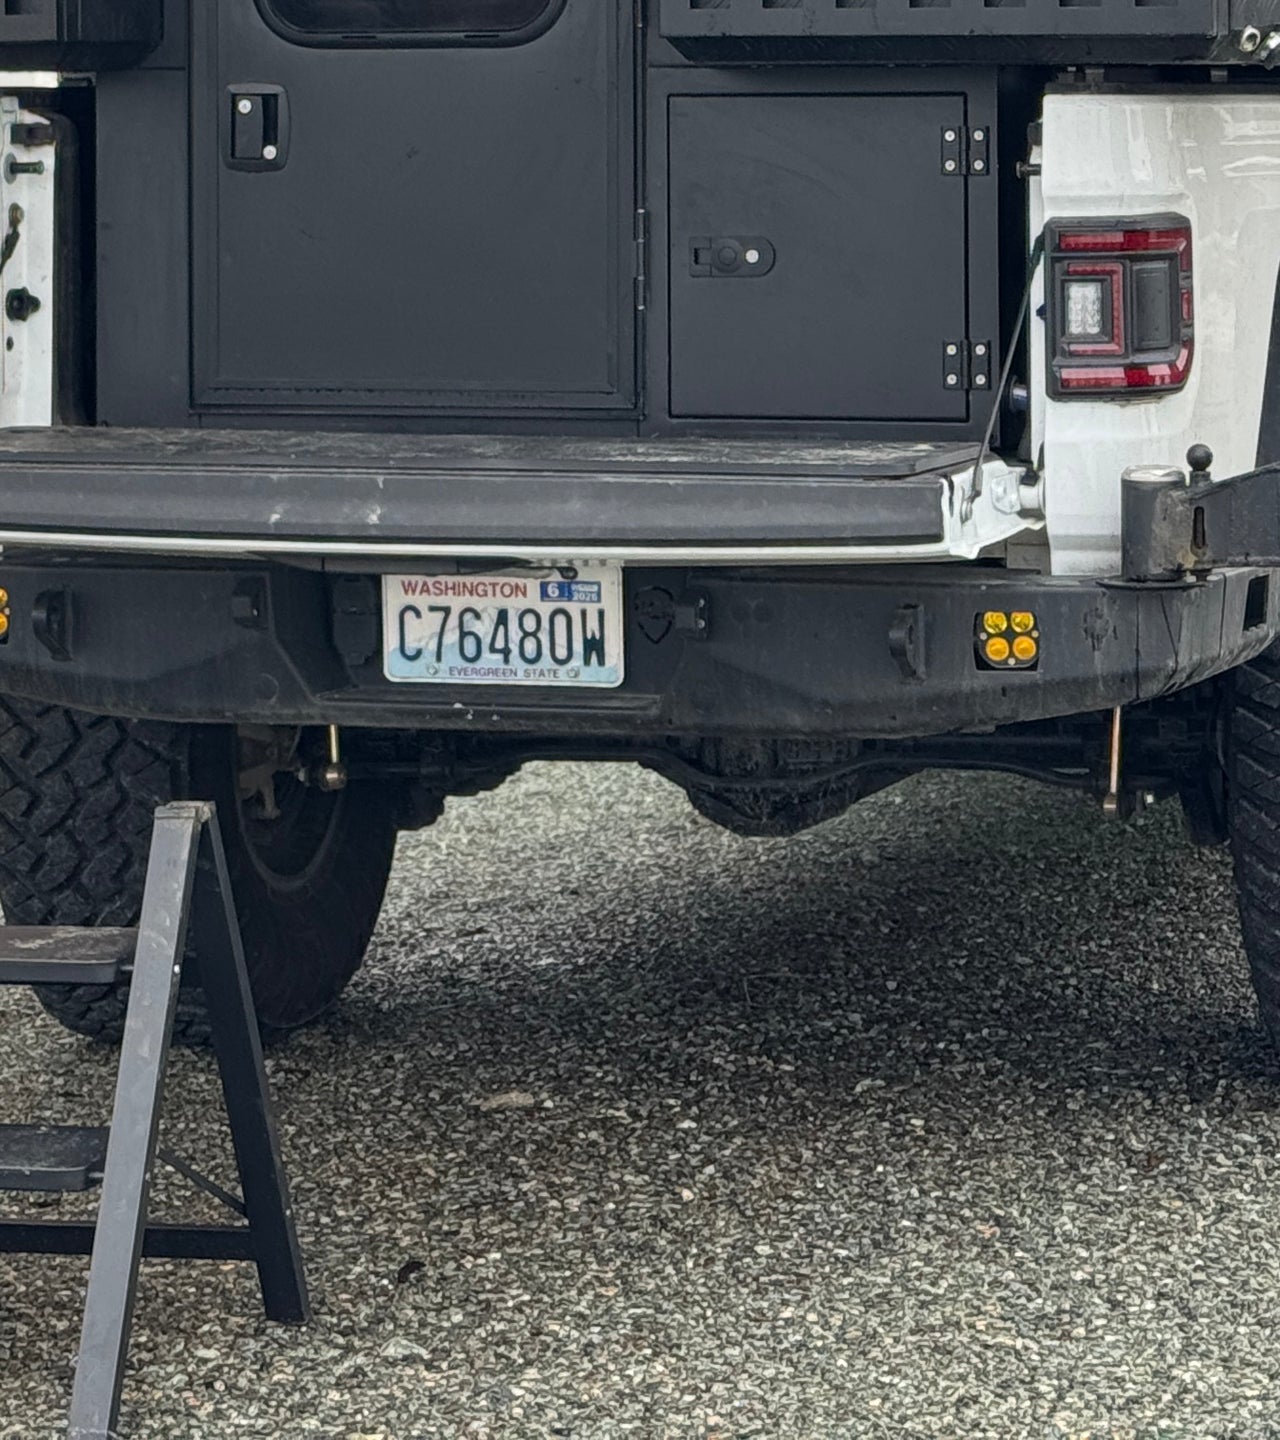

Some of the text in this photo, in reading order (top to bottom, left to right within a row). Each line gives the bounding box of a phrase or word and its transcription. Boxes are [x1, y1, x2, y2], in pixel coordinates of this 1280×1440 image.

[401, 580, 528, 598] WASHINGTON
[547, 583, 560, 597] 6
[399, 604, 606, 667] C76480W
[449, 666, 560, 678] EVERGREEN STATE
